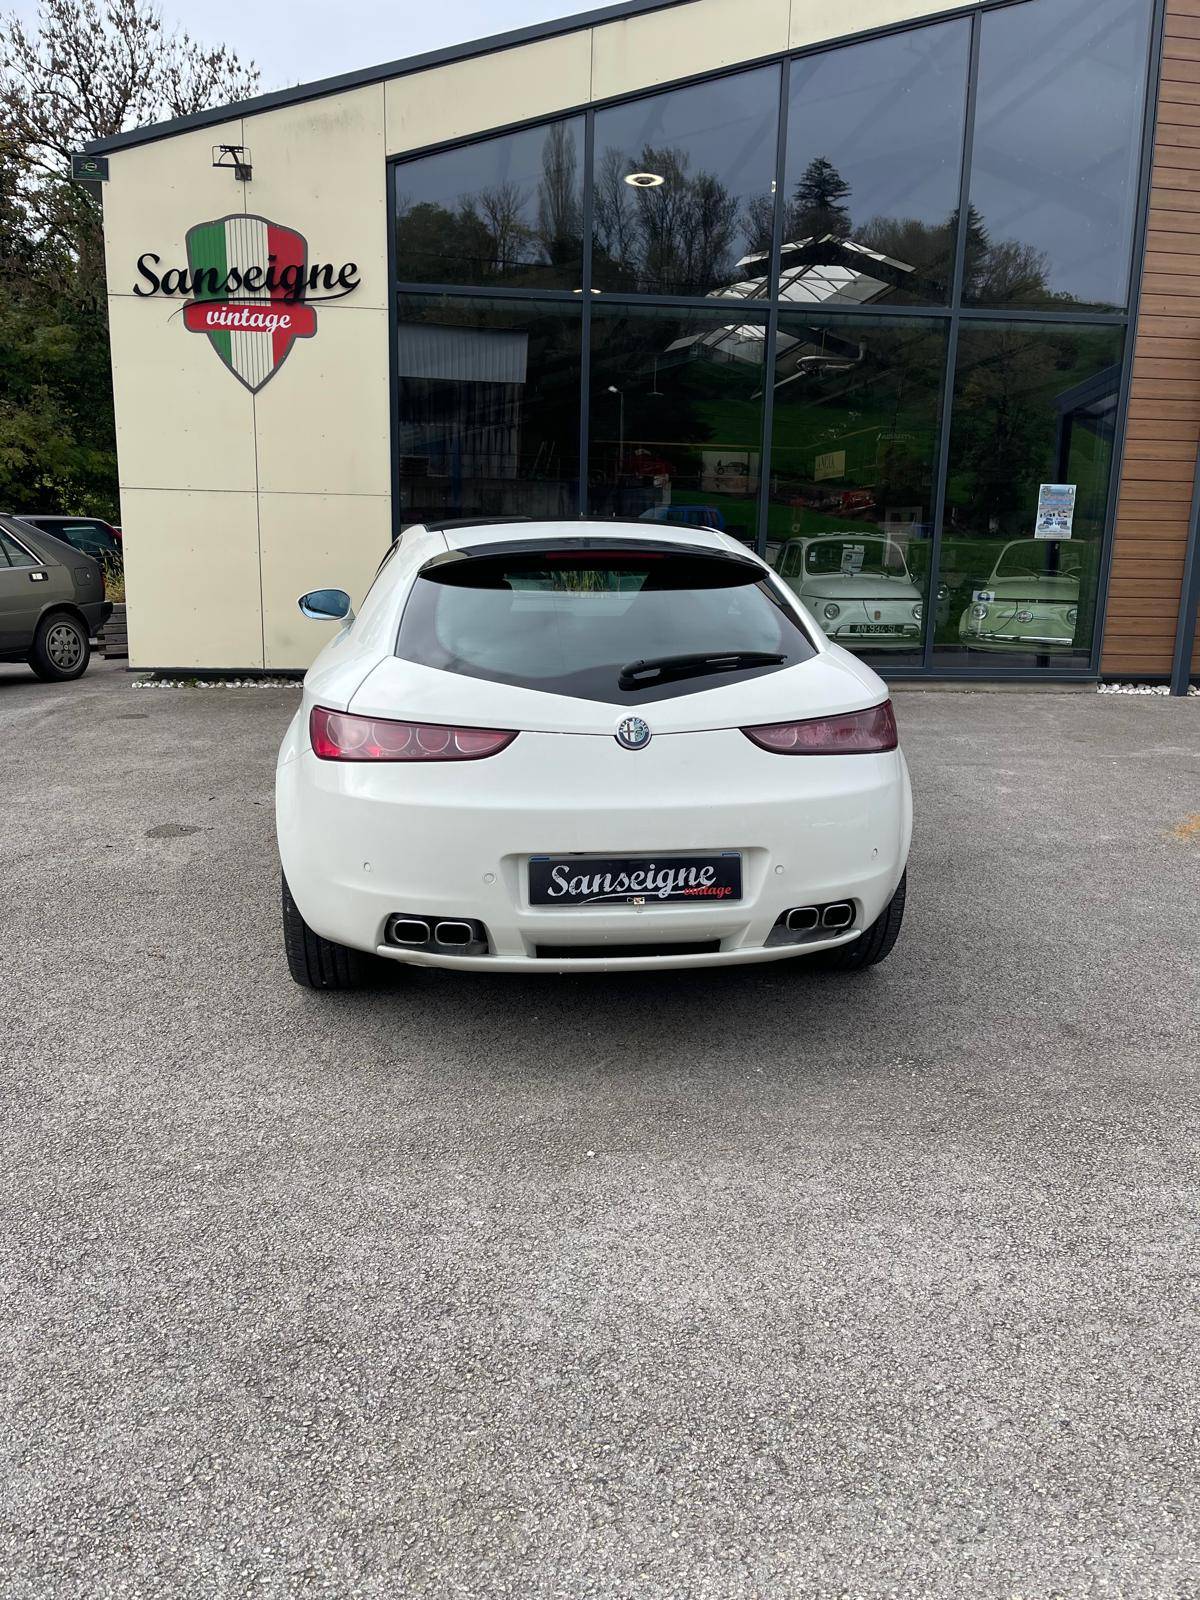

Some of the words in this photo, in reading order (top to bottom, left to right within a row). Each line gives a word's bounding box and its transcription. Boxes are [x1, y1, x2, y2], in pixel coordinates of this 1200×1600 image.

[133, 253, 361, 306] Sanseigne
[206, 307, 292, 333] vintage
[547, 864, 717, 898] Sanseigne
[684, 885, 733, 898] vintage
